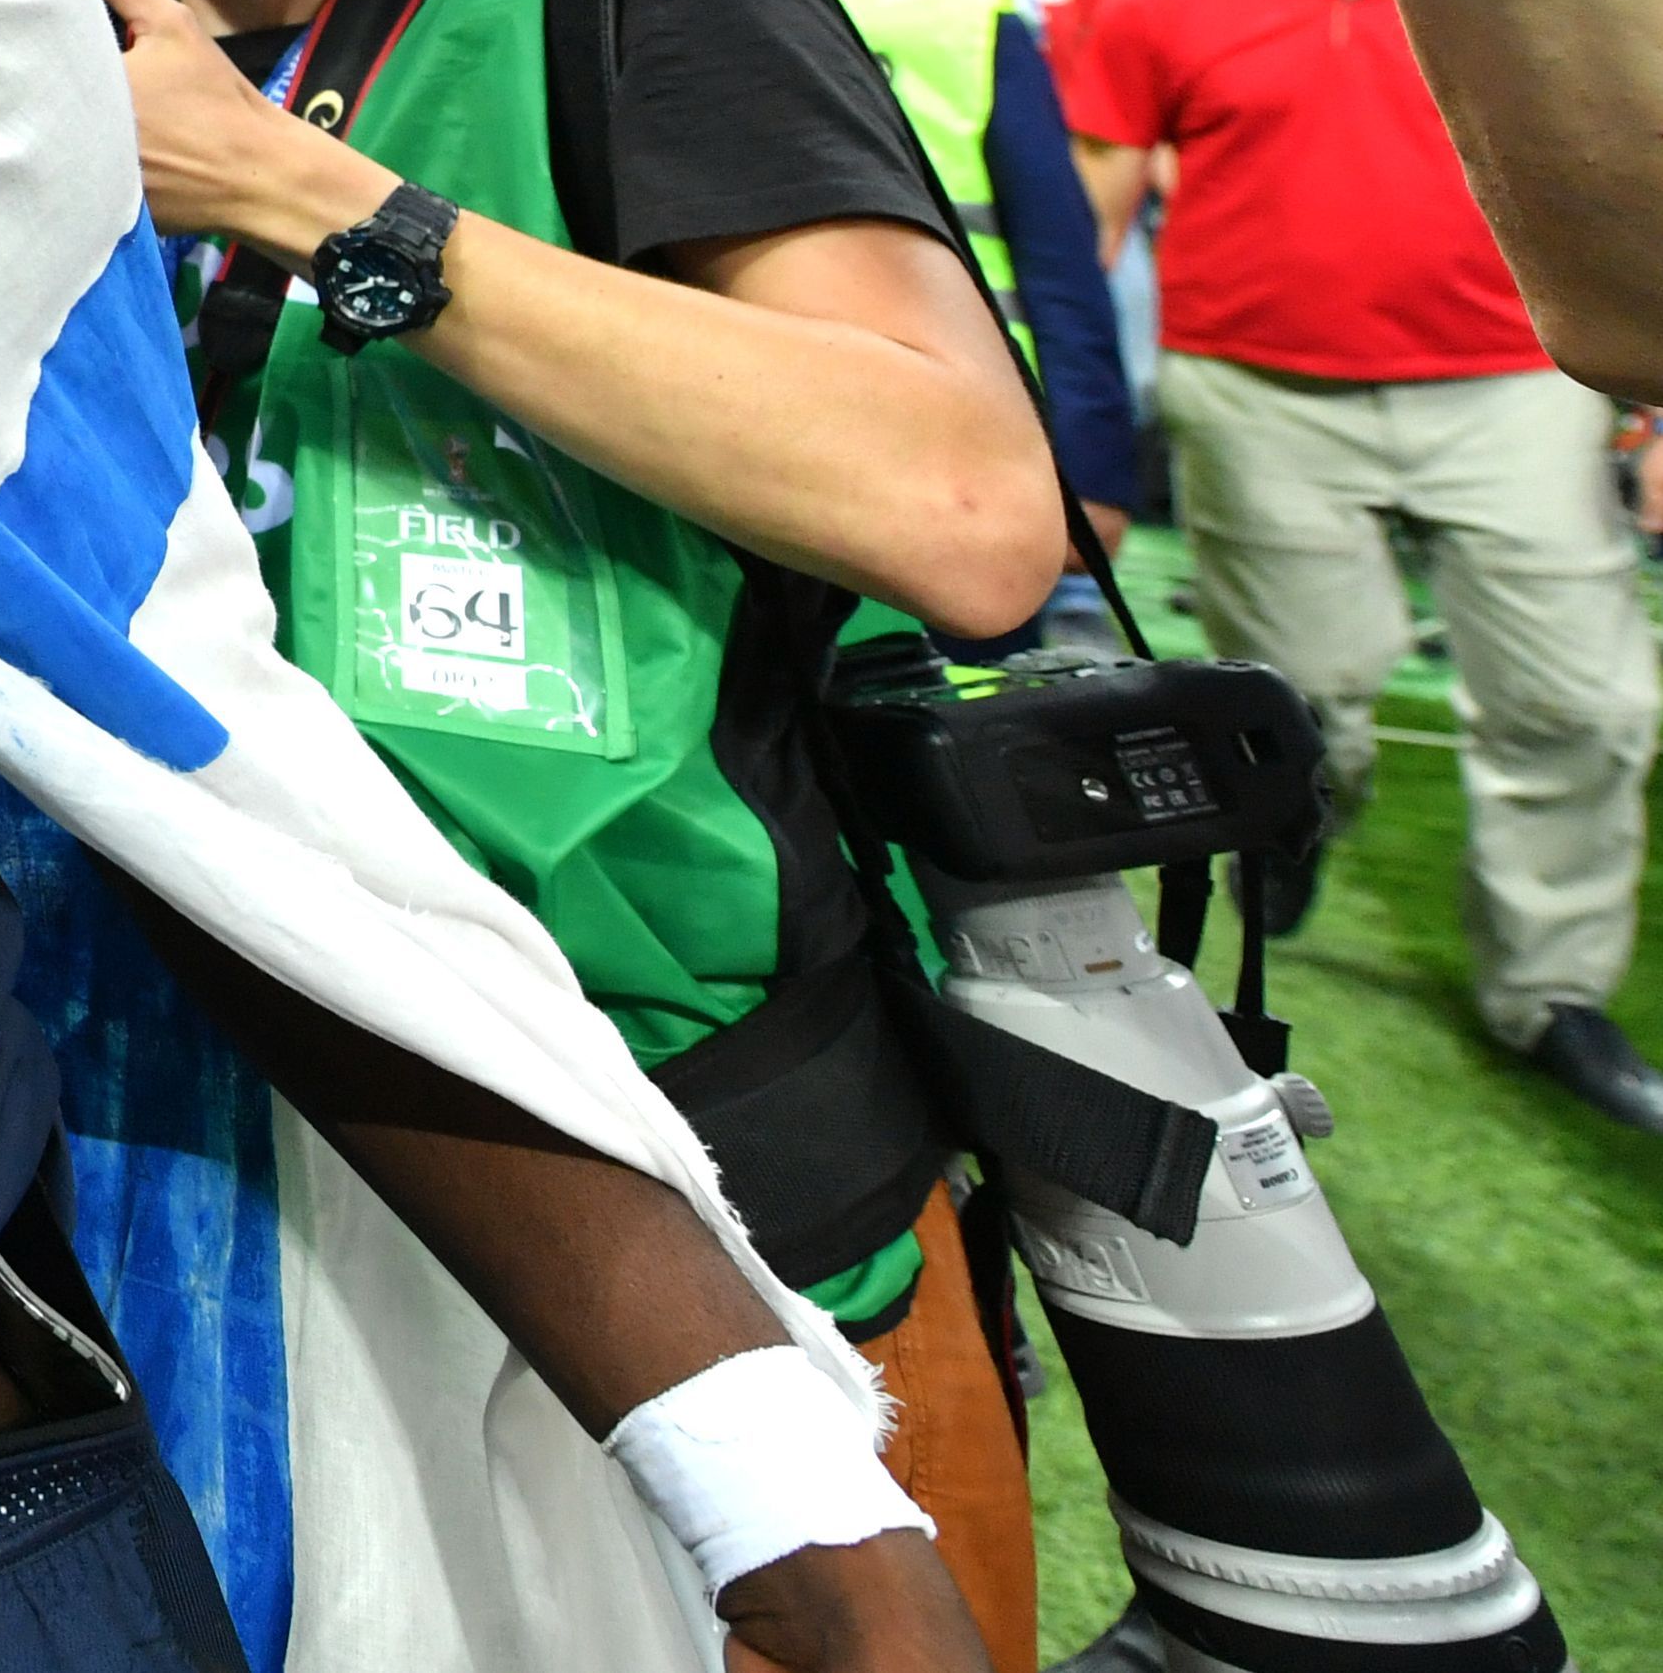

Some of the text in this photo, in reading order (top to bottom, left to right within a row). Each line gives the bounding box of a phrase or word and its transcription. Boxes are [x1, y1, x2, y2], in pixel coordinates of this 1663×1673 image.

[398, 509, 521, 551] FIELD
[408, 583, 518, 648] 64
[1259, 1168, 1299, 1189] Canon
